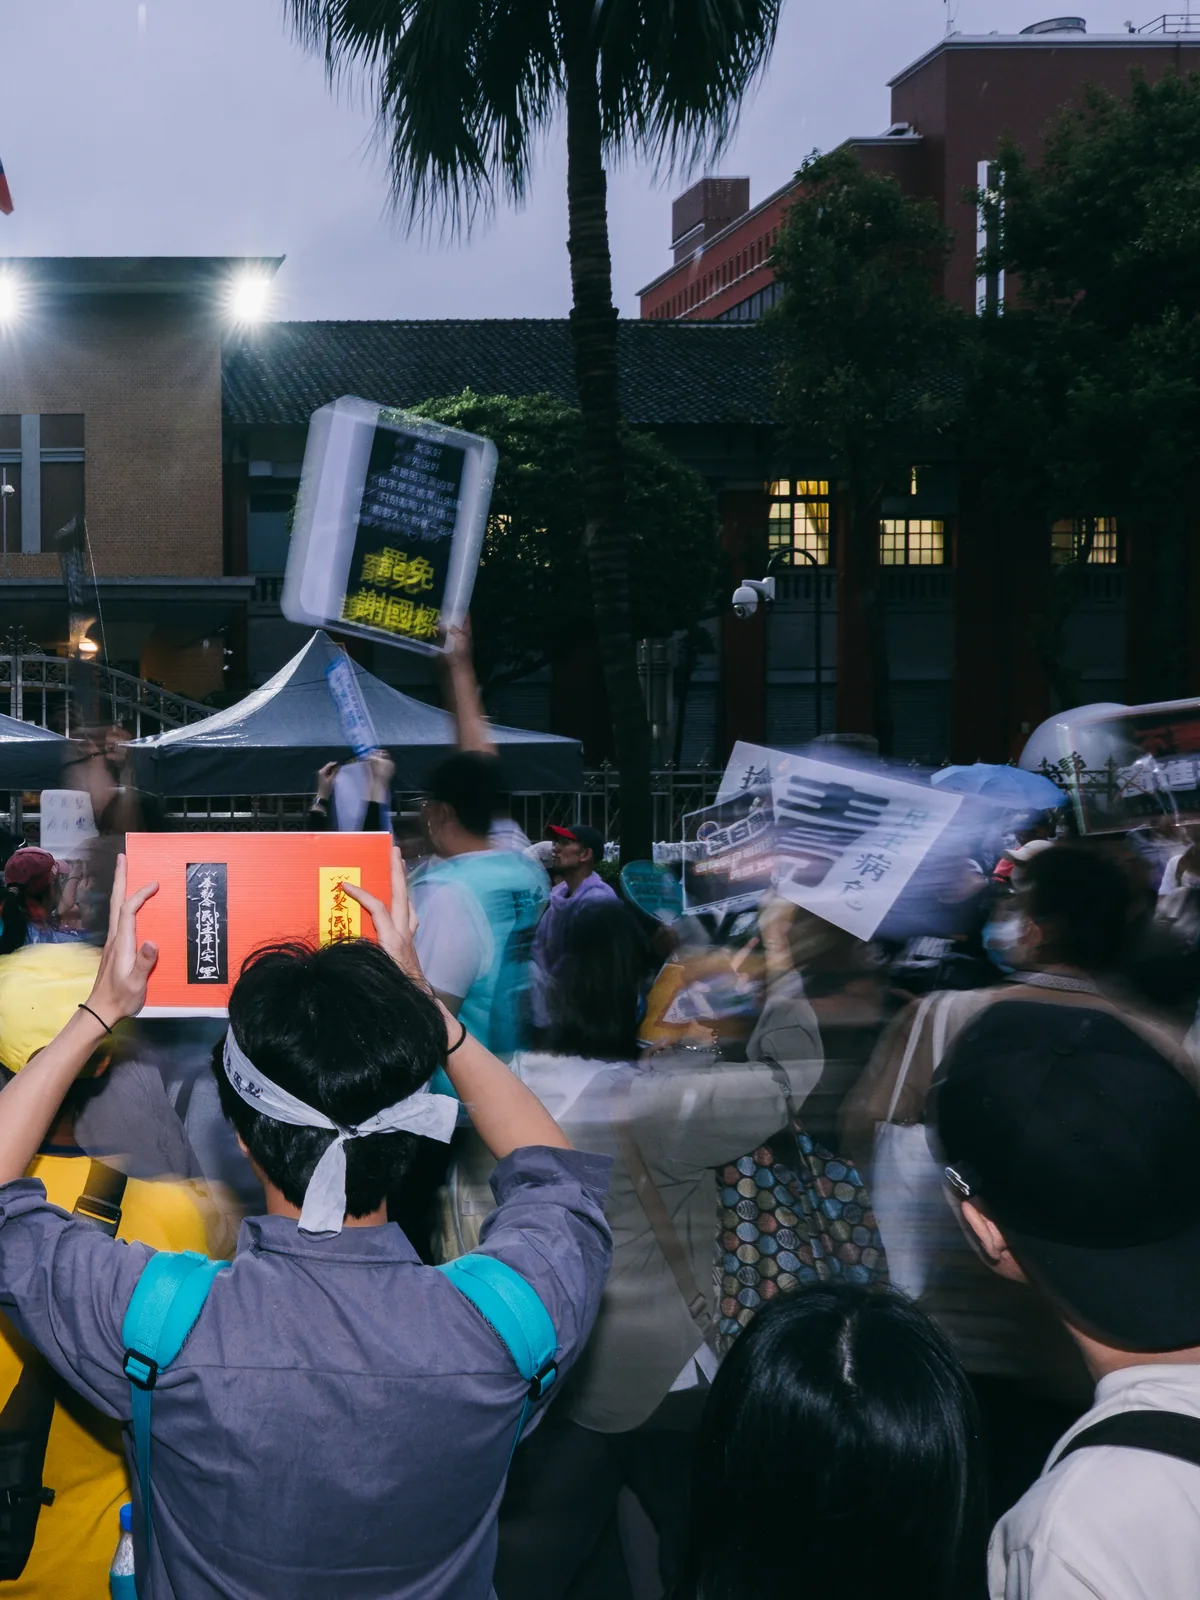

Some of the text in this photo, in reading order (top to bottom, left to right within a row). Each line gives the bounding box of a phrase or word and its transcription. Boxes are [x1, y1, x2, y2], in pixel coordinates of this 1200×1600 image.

[378, 546, 435, 590] 罷免
[353, 587, 441, 638] 謝國樑
